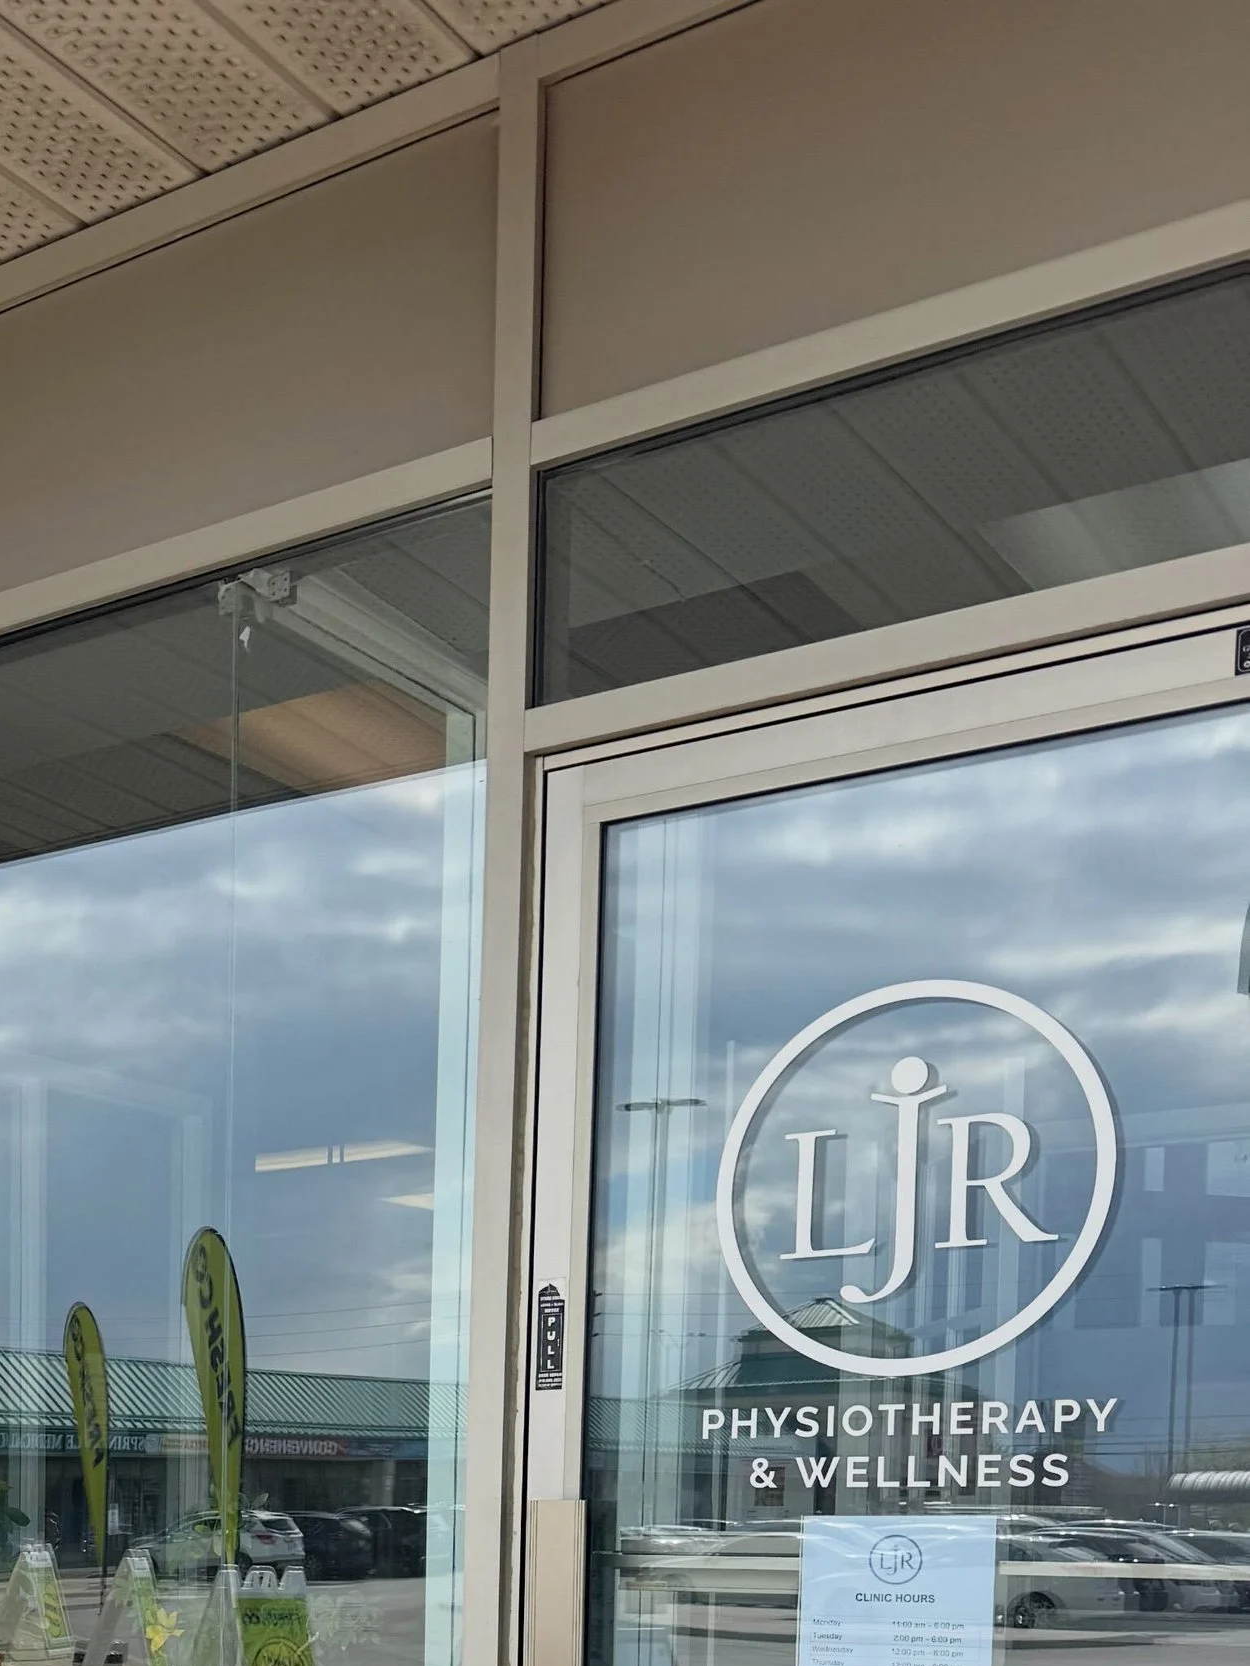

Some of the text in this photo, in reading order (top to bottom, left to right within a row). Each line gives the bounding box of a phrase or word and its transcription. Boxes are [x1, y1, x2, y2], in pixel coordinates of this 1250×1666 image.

[780, 1056, 1059, 1304] LJR
[547, 1316, 556, 1369] PULL
[702, 1398, 1118, 1439] PHYSIOTHERAPY
[750, 1453, 1070, 1489] & WELLNESS
[855, 1592, 936, 1604] CLINIC HOURS
[813, 1618, 841, 1627] Monday
[813, 1632, 842, 1641] Tuesday
[812, 1645, 853, 1654] Wednesday
[811, 1658, 845, 1666] Thursday
